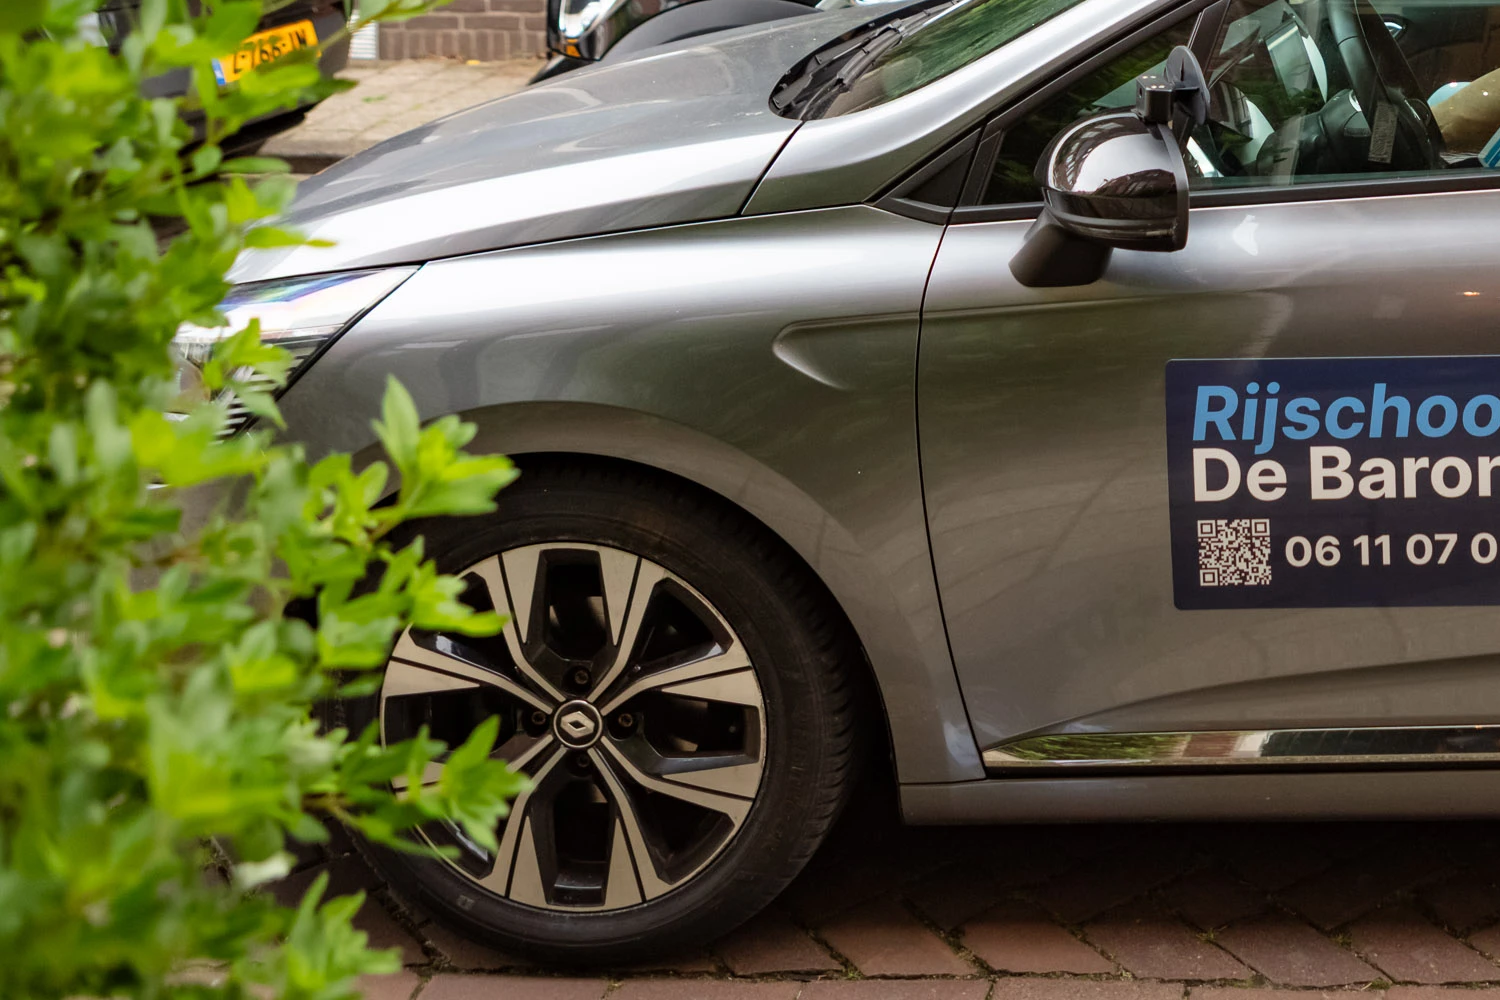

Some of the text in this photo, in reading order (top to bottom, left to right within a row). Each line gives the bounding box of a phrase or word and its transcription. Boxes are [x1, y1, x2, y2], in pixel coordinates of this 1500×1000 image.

[1192, 446, 1287, 502] De
[1285, 535, 1341, 567] 06
[1353, 534, 1391, 566] 11
[1406, 533, 1458, 565] 07
